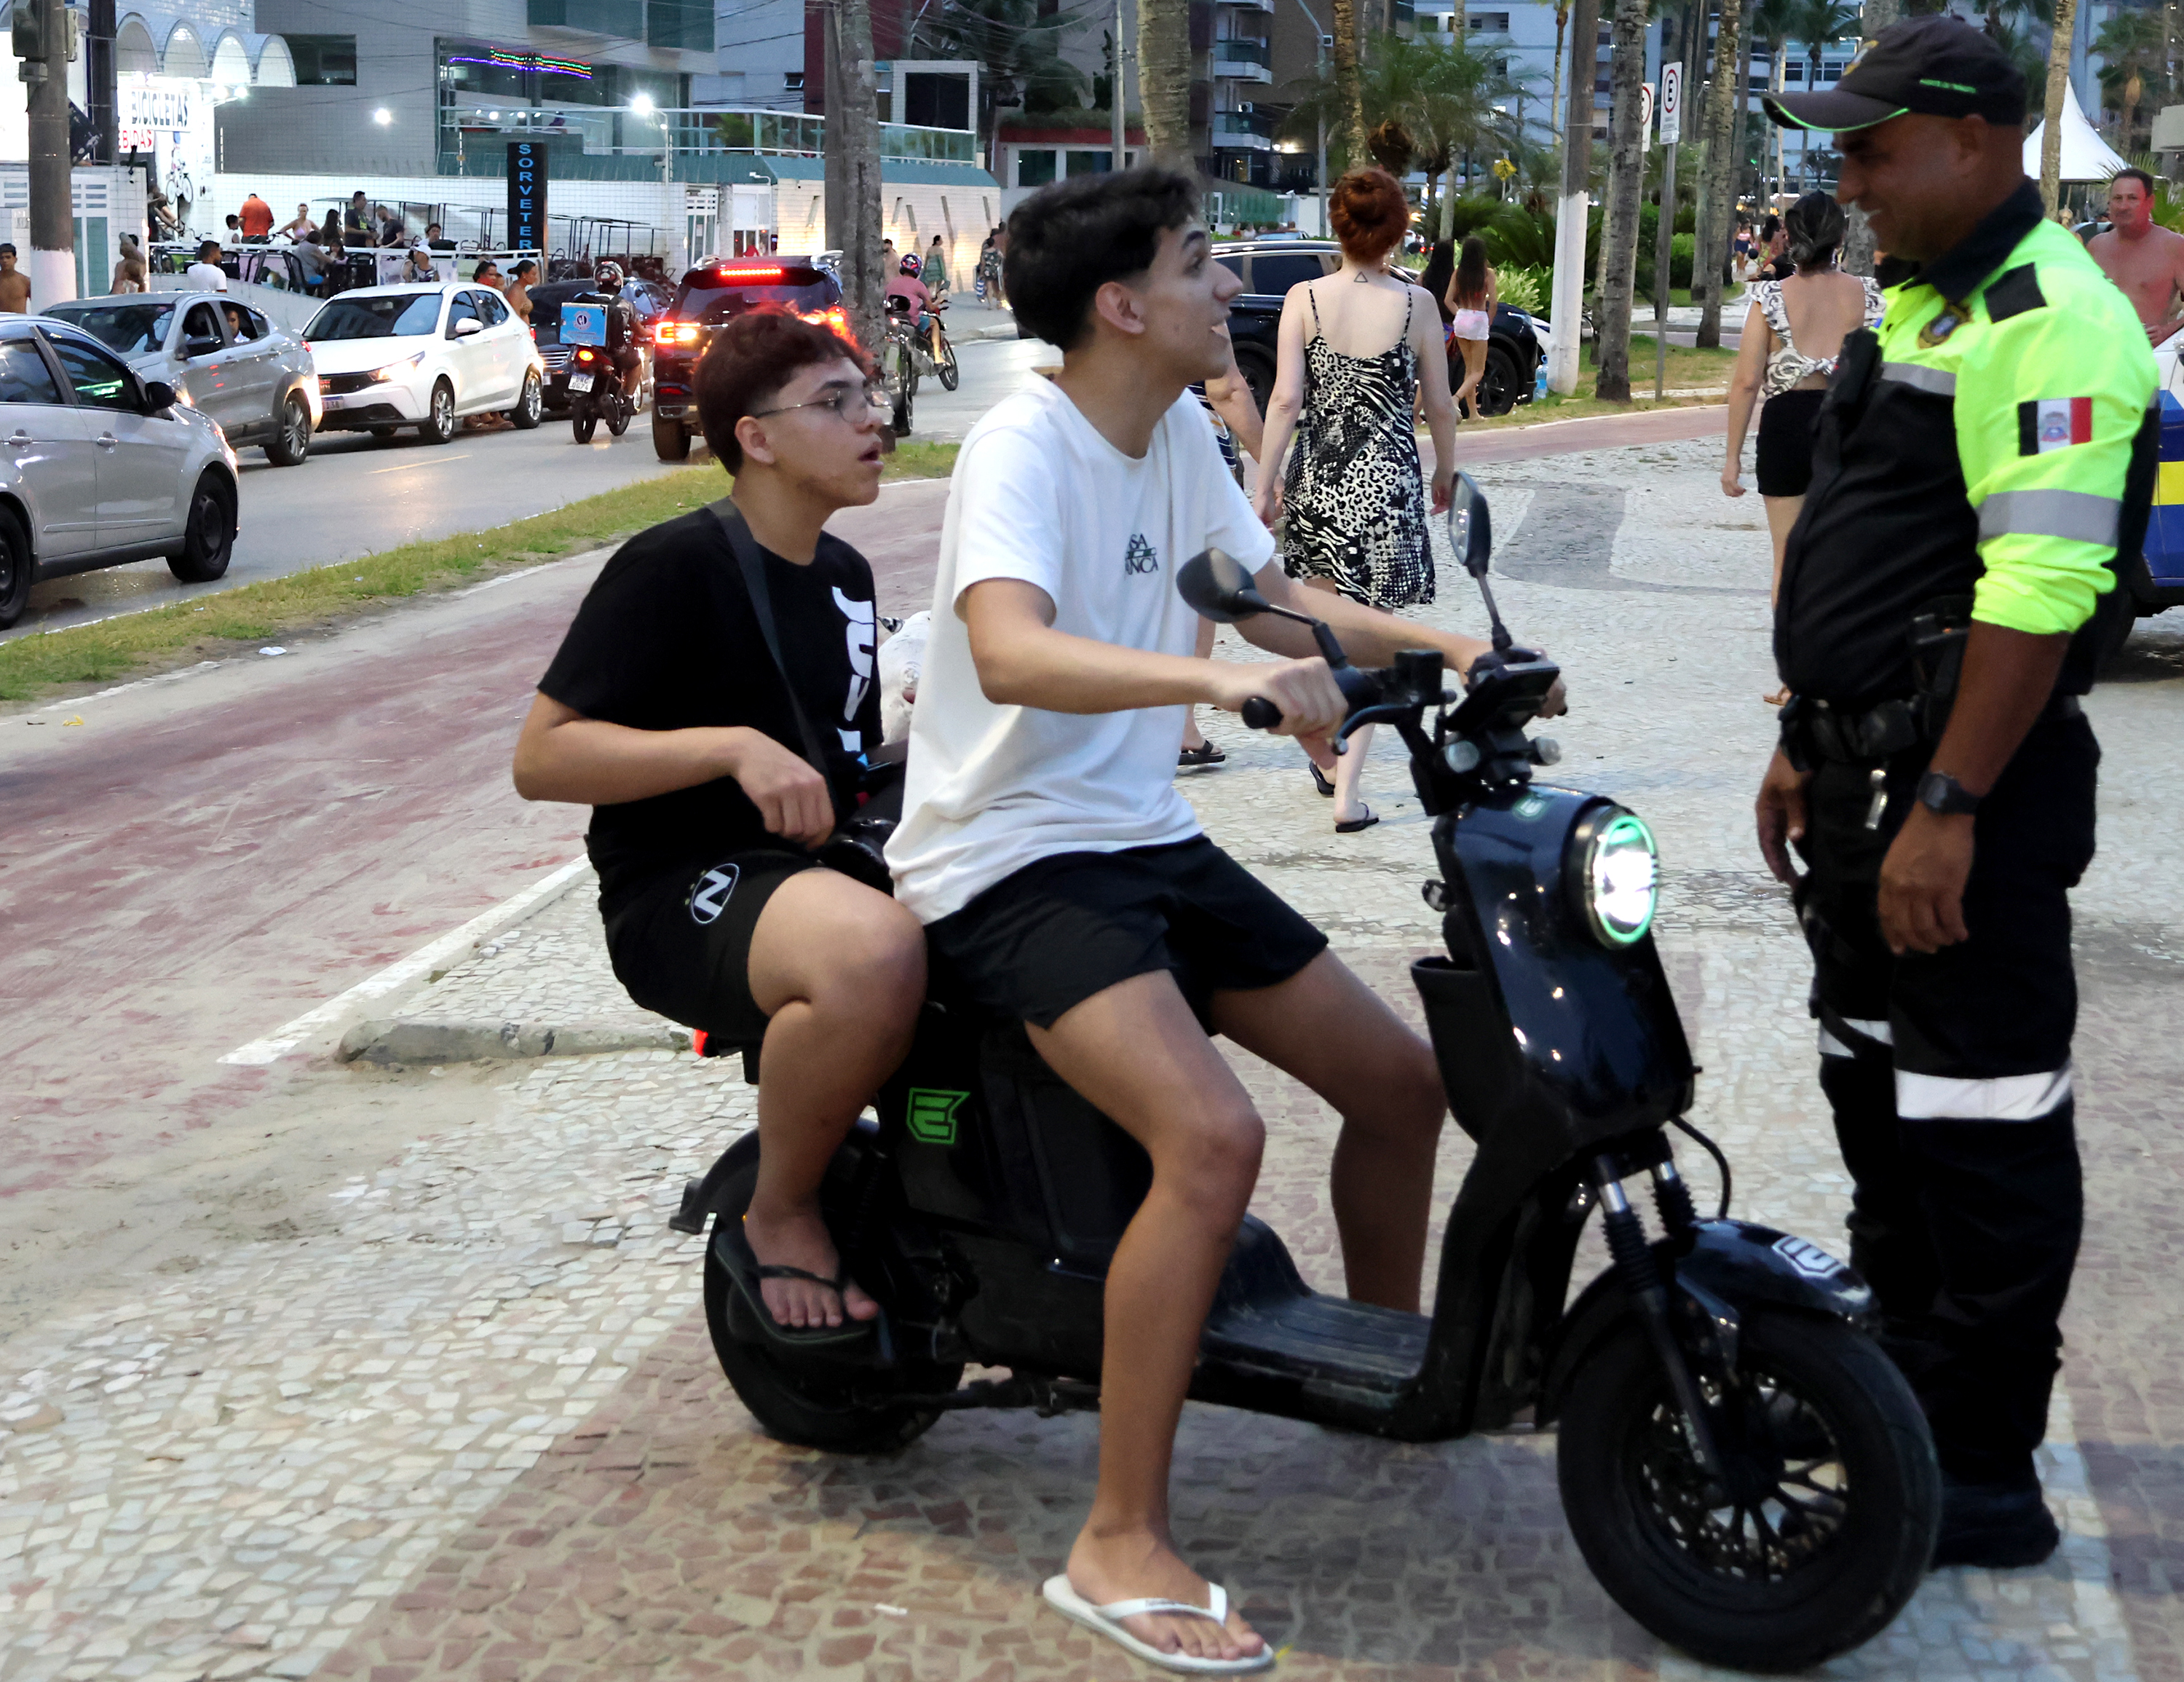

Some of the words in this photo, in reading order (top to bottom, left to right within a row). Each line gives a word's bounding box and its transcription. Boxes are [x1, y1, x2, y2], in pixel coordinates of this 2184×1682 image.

[1668, 79, 1674, 102] E
[131, 90, 189, 127] BICICLETAS
[118, 130, 152, 149] BIDAS
